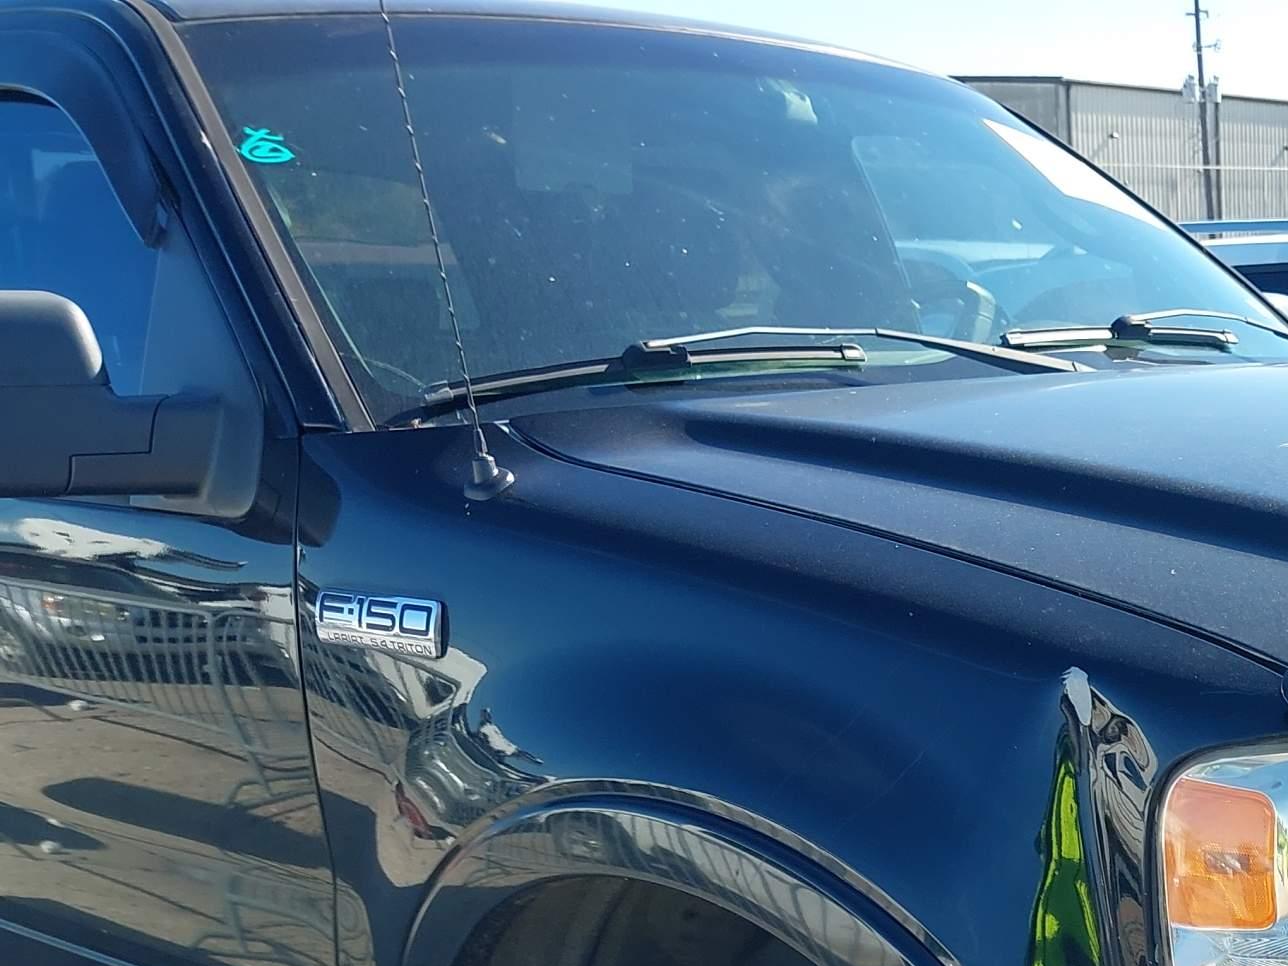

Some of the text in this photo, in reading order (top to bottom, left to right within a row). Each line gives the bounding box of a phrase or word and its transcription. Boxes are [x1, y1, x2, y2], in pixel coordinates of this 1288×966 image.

[319, 592, 433, 637] F-150
[327, 631, 364, 644] LARIAT
[390, 640, 433, 656] TRITON
